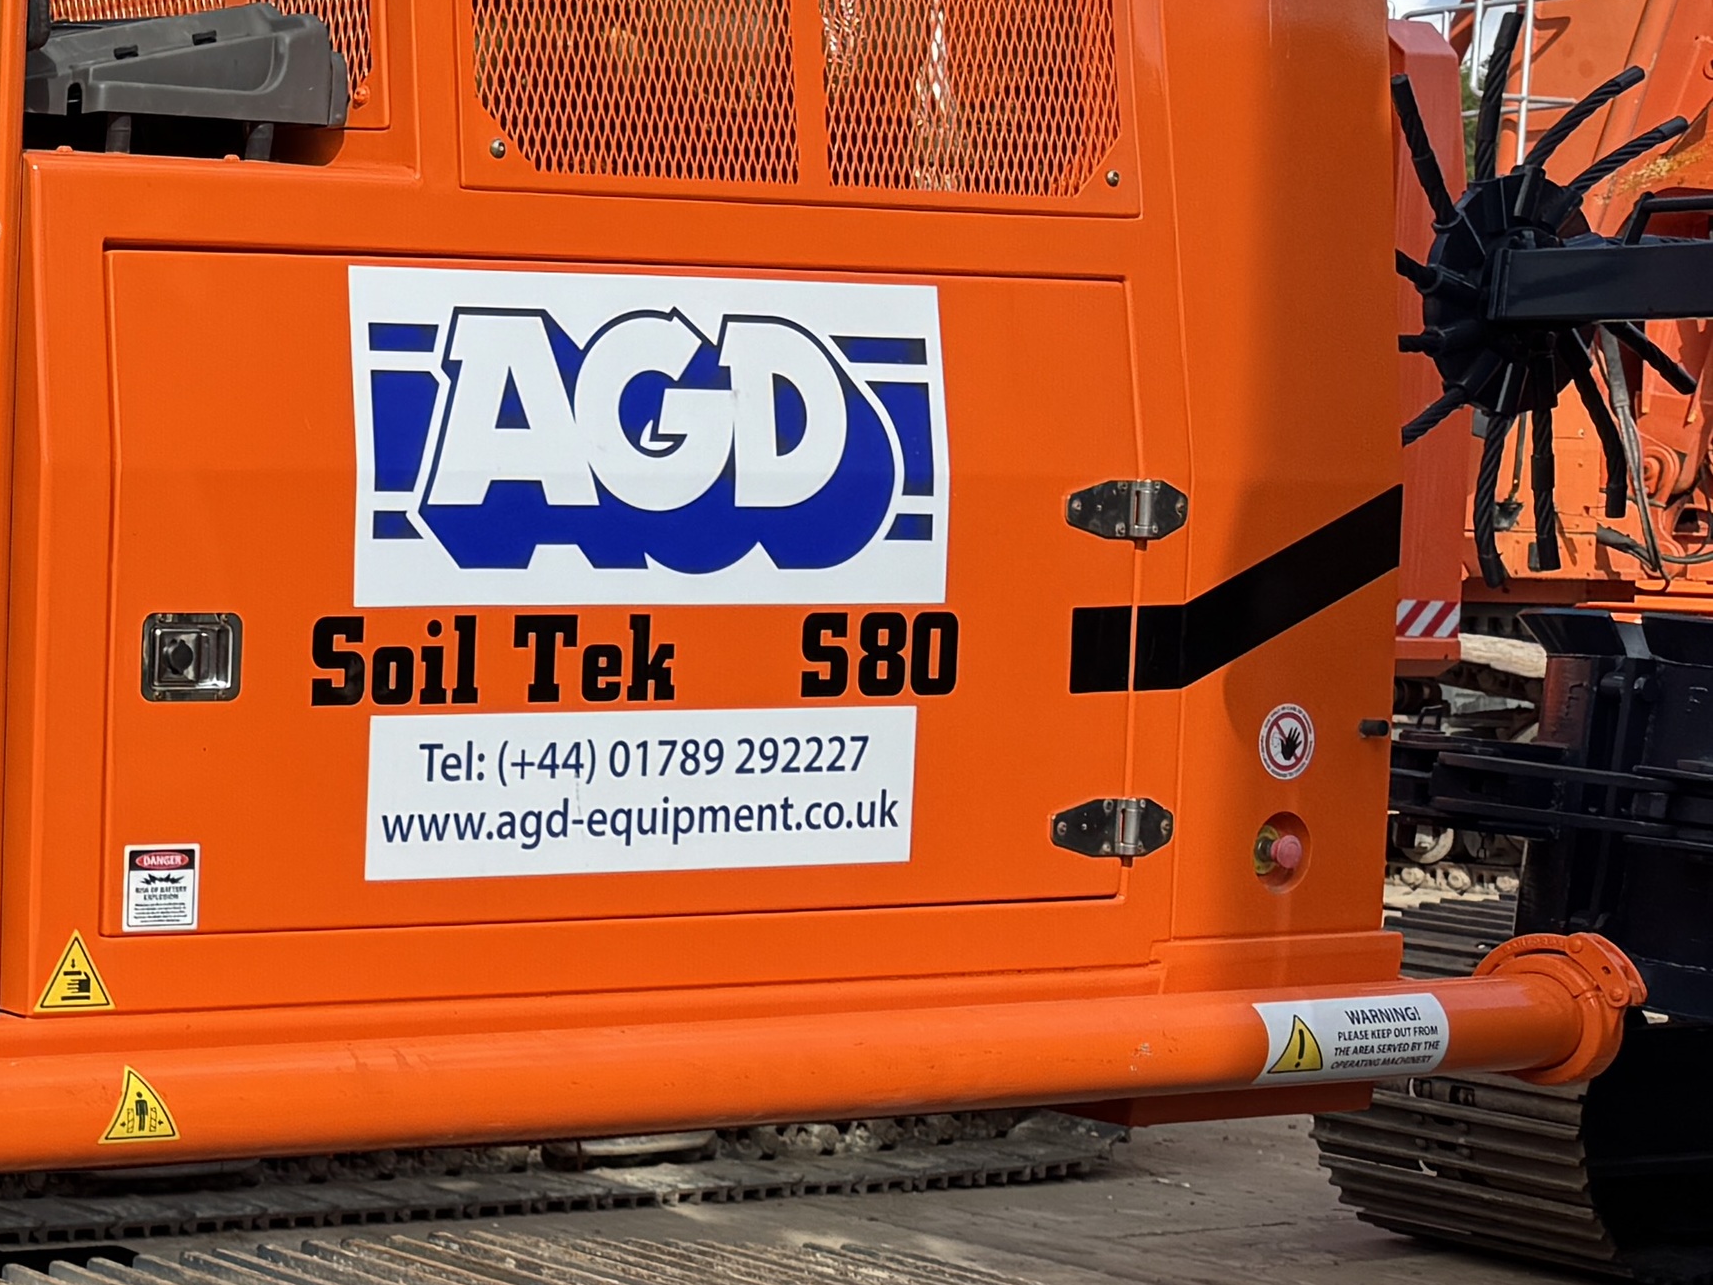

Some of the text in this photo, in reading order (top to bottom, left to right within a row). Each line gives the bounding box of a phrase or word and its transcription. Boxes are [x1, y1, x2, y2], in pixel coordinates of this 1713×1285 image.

[419, 306, 895, 574] AGD
[311, 611, 959, 707] Soil Tek S80
[418, 735, 870, 787] Tel: (+44) 01789 292227
[381, 788, 899, 850] www.agd-equipment.co.uk
[143, 855, 182, 866] DANGER
[1345, 1006, 1421, 1025] WARNING!
[1338, 1025, 1438, 1042] PLEASE KEEP OUT FROM
[1334, 1040, 1440, 1057] THE AREA SERVED BY THE
[1330, 1058, 1381, 1070] OPERATING
